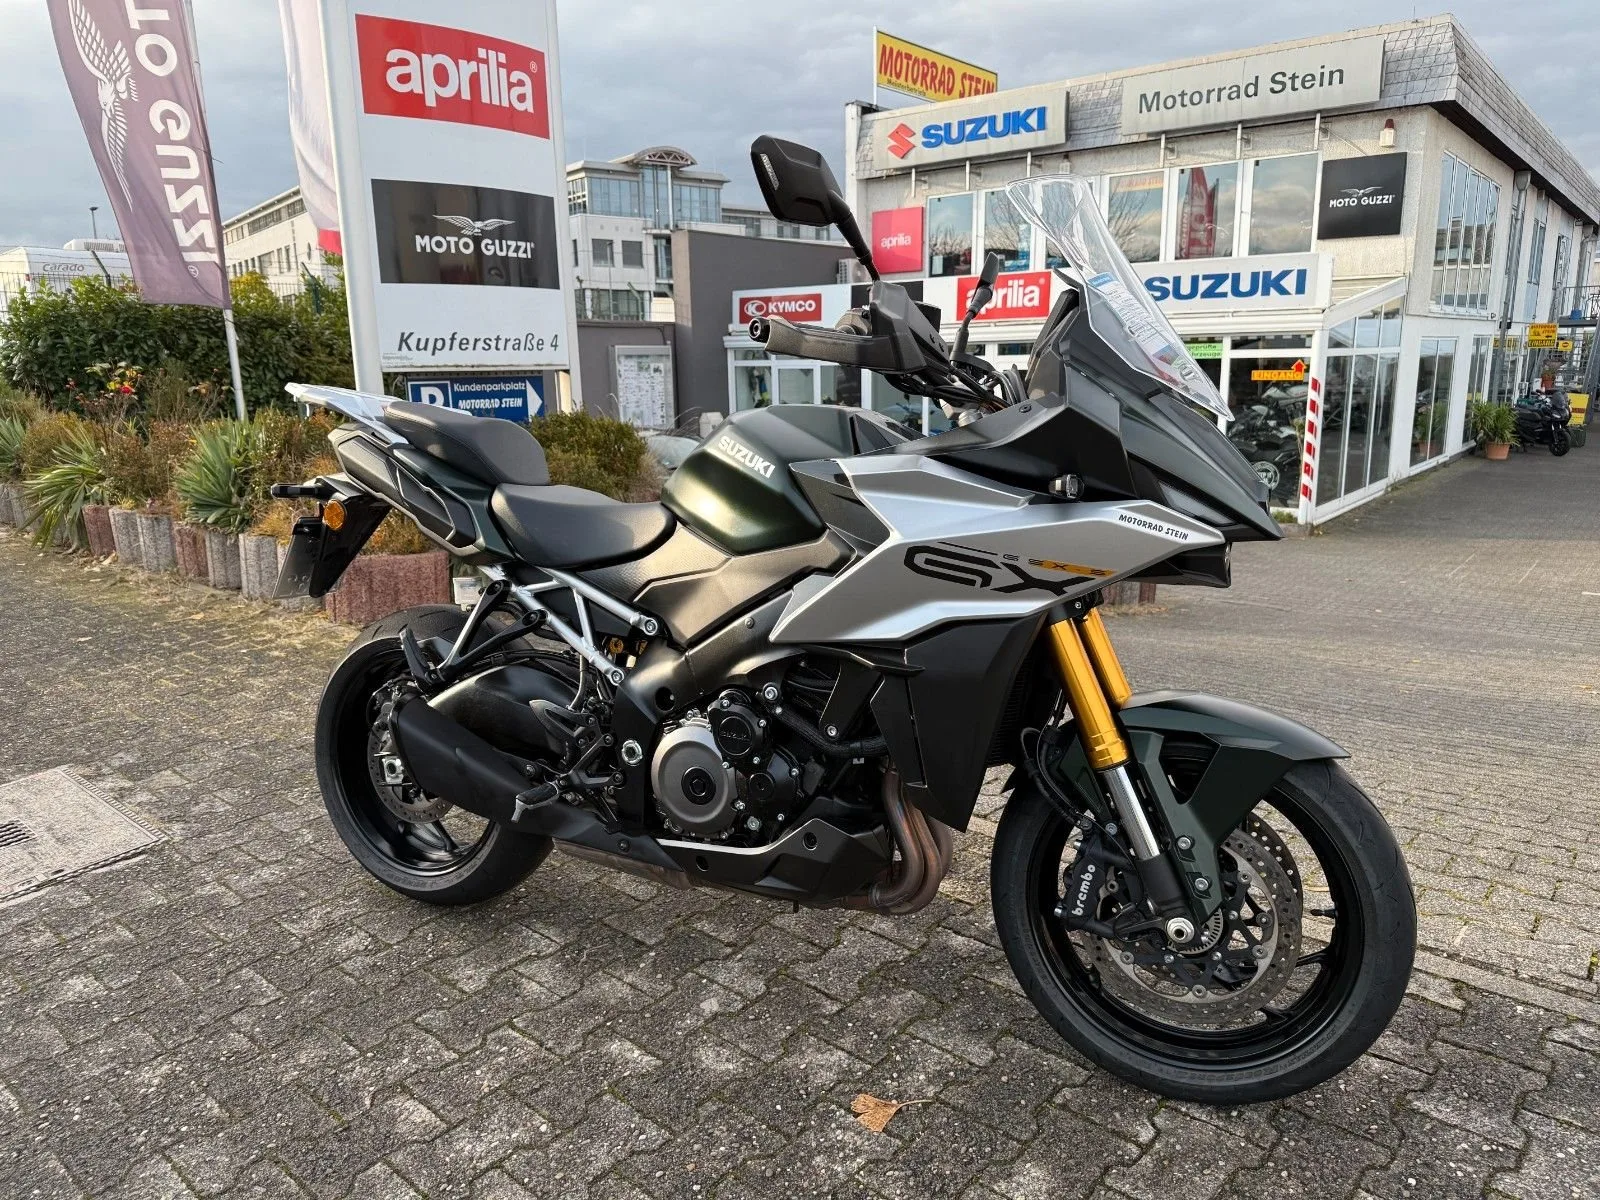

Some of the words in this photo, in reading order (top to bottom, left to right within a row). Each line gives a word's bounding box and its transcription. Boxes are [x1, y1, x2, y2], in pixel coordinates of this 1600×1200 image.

[385, 48, 535, 114] aprilia
[879, 44, 956, 96] MOTORRAD
[1138, 75, 1259, 114] Motorrad
[1269, 65, 1344, 94] Stein
[921, 106, 1047, 149] SUZUKI
[1329, 198, 1357, 208] MOTO
[1361, 194, 1393, 205] GUZZI
[415, 235, 474, 254] MOTO
[480, 239, 532, 259] GUZZI
[880, 233, 912, 250] aprilia
[42, 263, 85, 272] Carado
[1144, 268, 1307, 302] SUZUKI
[768, 299, 816, 313] KYMCO
[397, 331, 545, 356] Kupferstraße
[550, 334, 559, 351] 4
[453, 379, 526, 393] Kundenparkplatz
[1255, 371, 1302, 380] EINGANG
[420, 386, 445, 406] P
[458, 398, 500, 410] MOTORRAD
[501, 397, 523, 408] STEIN
[718, 435, 776, 479] SUZUKI
[1118, 514, 1164, 533] MOTORRAD
[1165, 527, 1189, 541] STEIN
[1071, 864, 1096, 916] brembo
